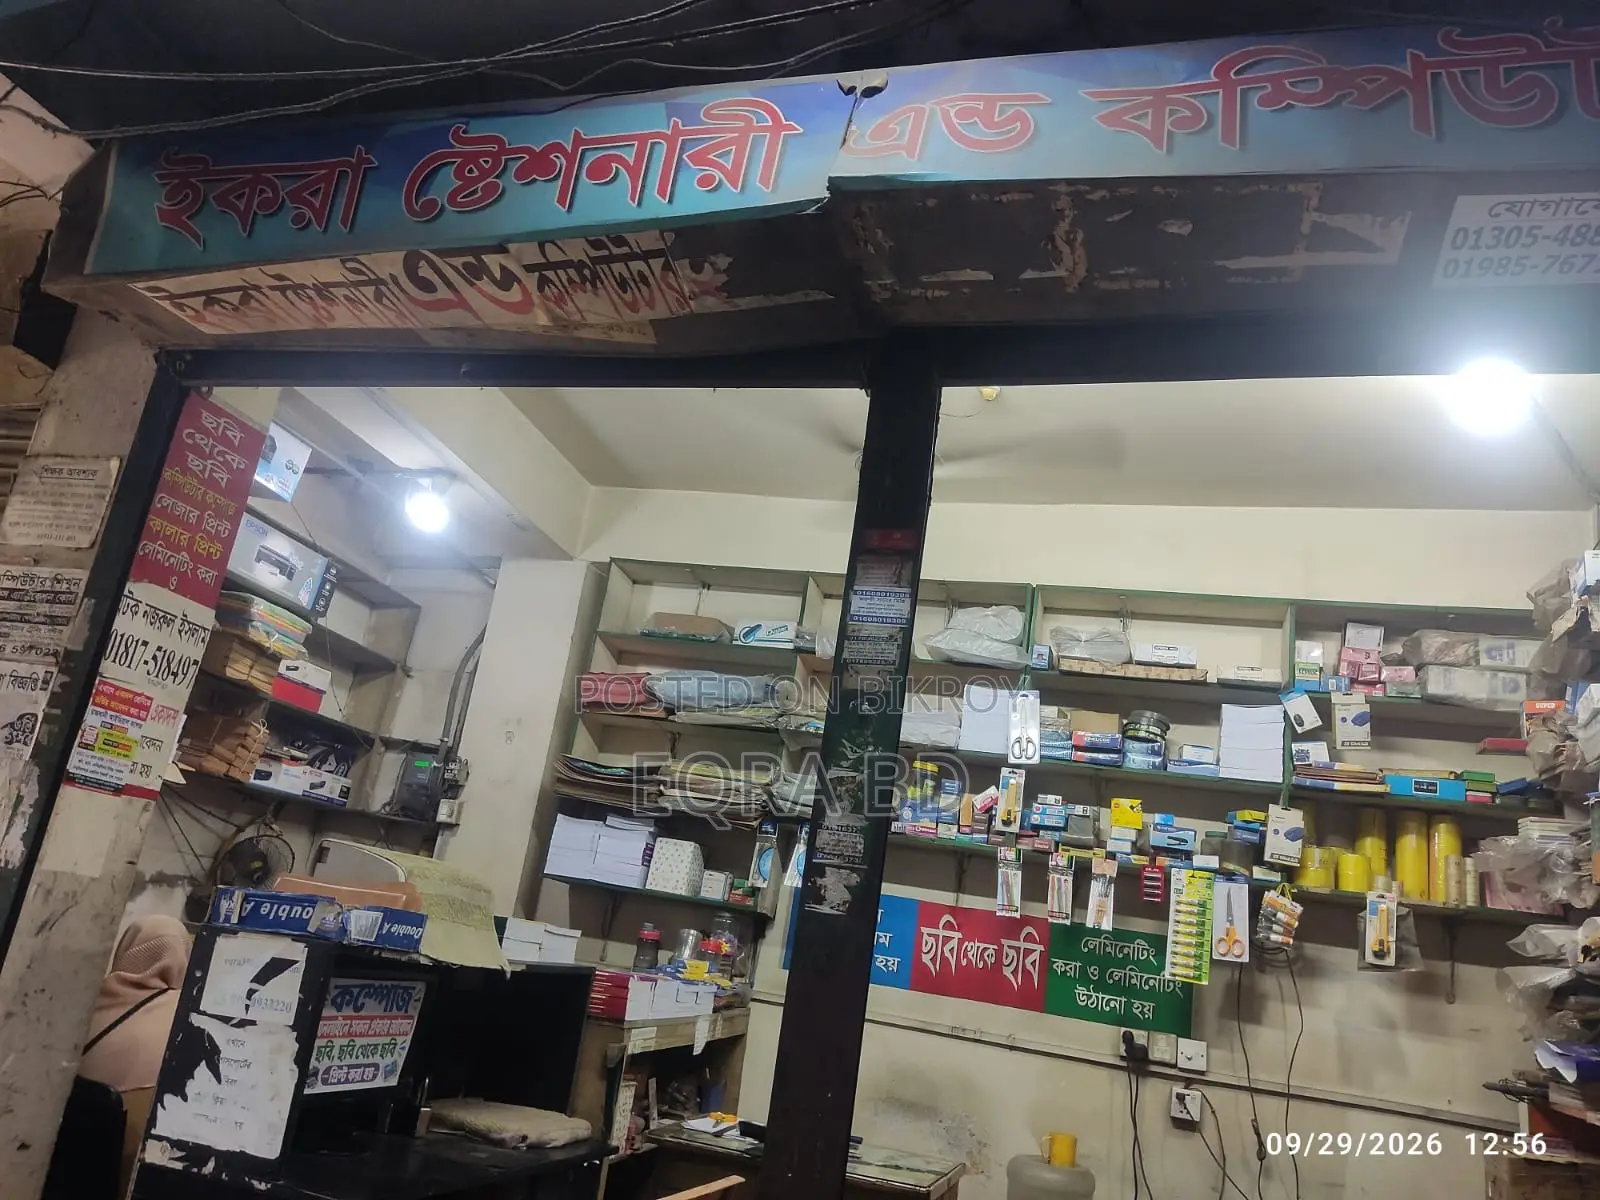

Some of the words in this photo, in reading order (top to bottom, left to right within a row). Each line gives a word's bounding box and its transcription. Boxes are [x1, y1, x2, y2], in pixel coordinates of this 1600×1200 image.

[154, 145, 377, 251] ইকরা
[402, 98, 802, 220] ষ্টেশনারী
[842, 92, 1051, 161] এন্ড
[200, 407, 245, 447] ছবি
[182, 428, 249, 469] থেকে
[186, 452, 231, 489] ছবি
[155, 493, 201, 525] লেজার
[202, 512, 232, 537] প্রিন্ট
[148, 515, 192, 547] কালার
[194, 534, 223, 560] প্রিন্ট
[138, 540, 194, 577] লেমিনেটিং
[197, 564, 218, 586] করা
[178, 609, 210, 648] ইসলাম
[104, 628, 200, 689] 01817-518497
[260, 903, 312, 921] ouble
[382, 923, 390, 934] A
[390, 921, 424, 938] Double
[874, 955, 901, 974] হয়
[920, 913, 962, 978] ছবি
[961, 940, 999, 970] থেকে
[1000, 926, 1045, 991] ছবি
[1081, 936, 1157, 966] লেমিনেটিং
[1051, 957, 1080, 978] করা
[1087, 966, 1099, 981] ও
[1106, 966, 1183, 998] লেমিনেটিং
[1075, 984, 1125, 1016] উঠানো
[1132, 999, 1155, 1021] হয়
[337, 1040, 357, 1063] ছবি
[356, 1043, 380, 1061] থেকে
[379, 1040, 397, 1060] ছবি
